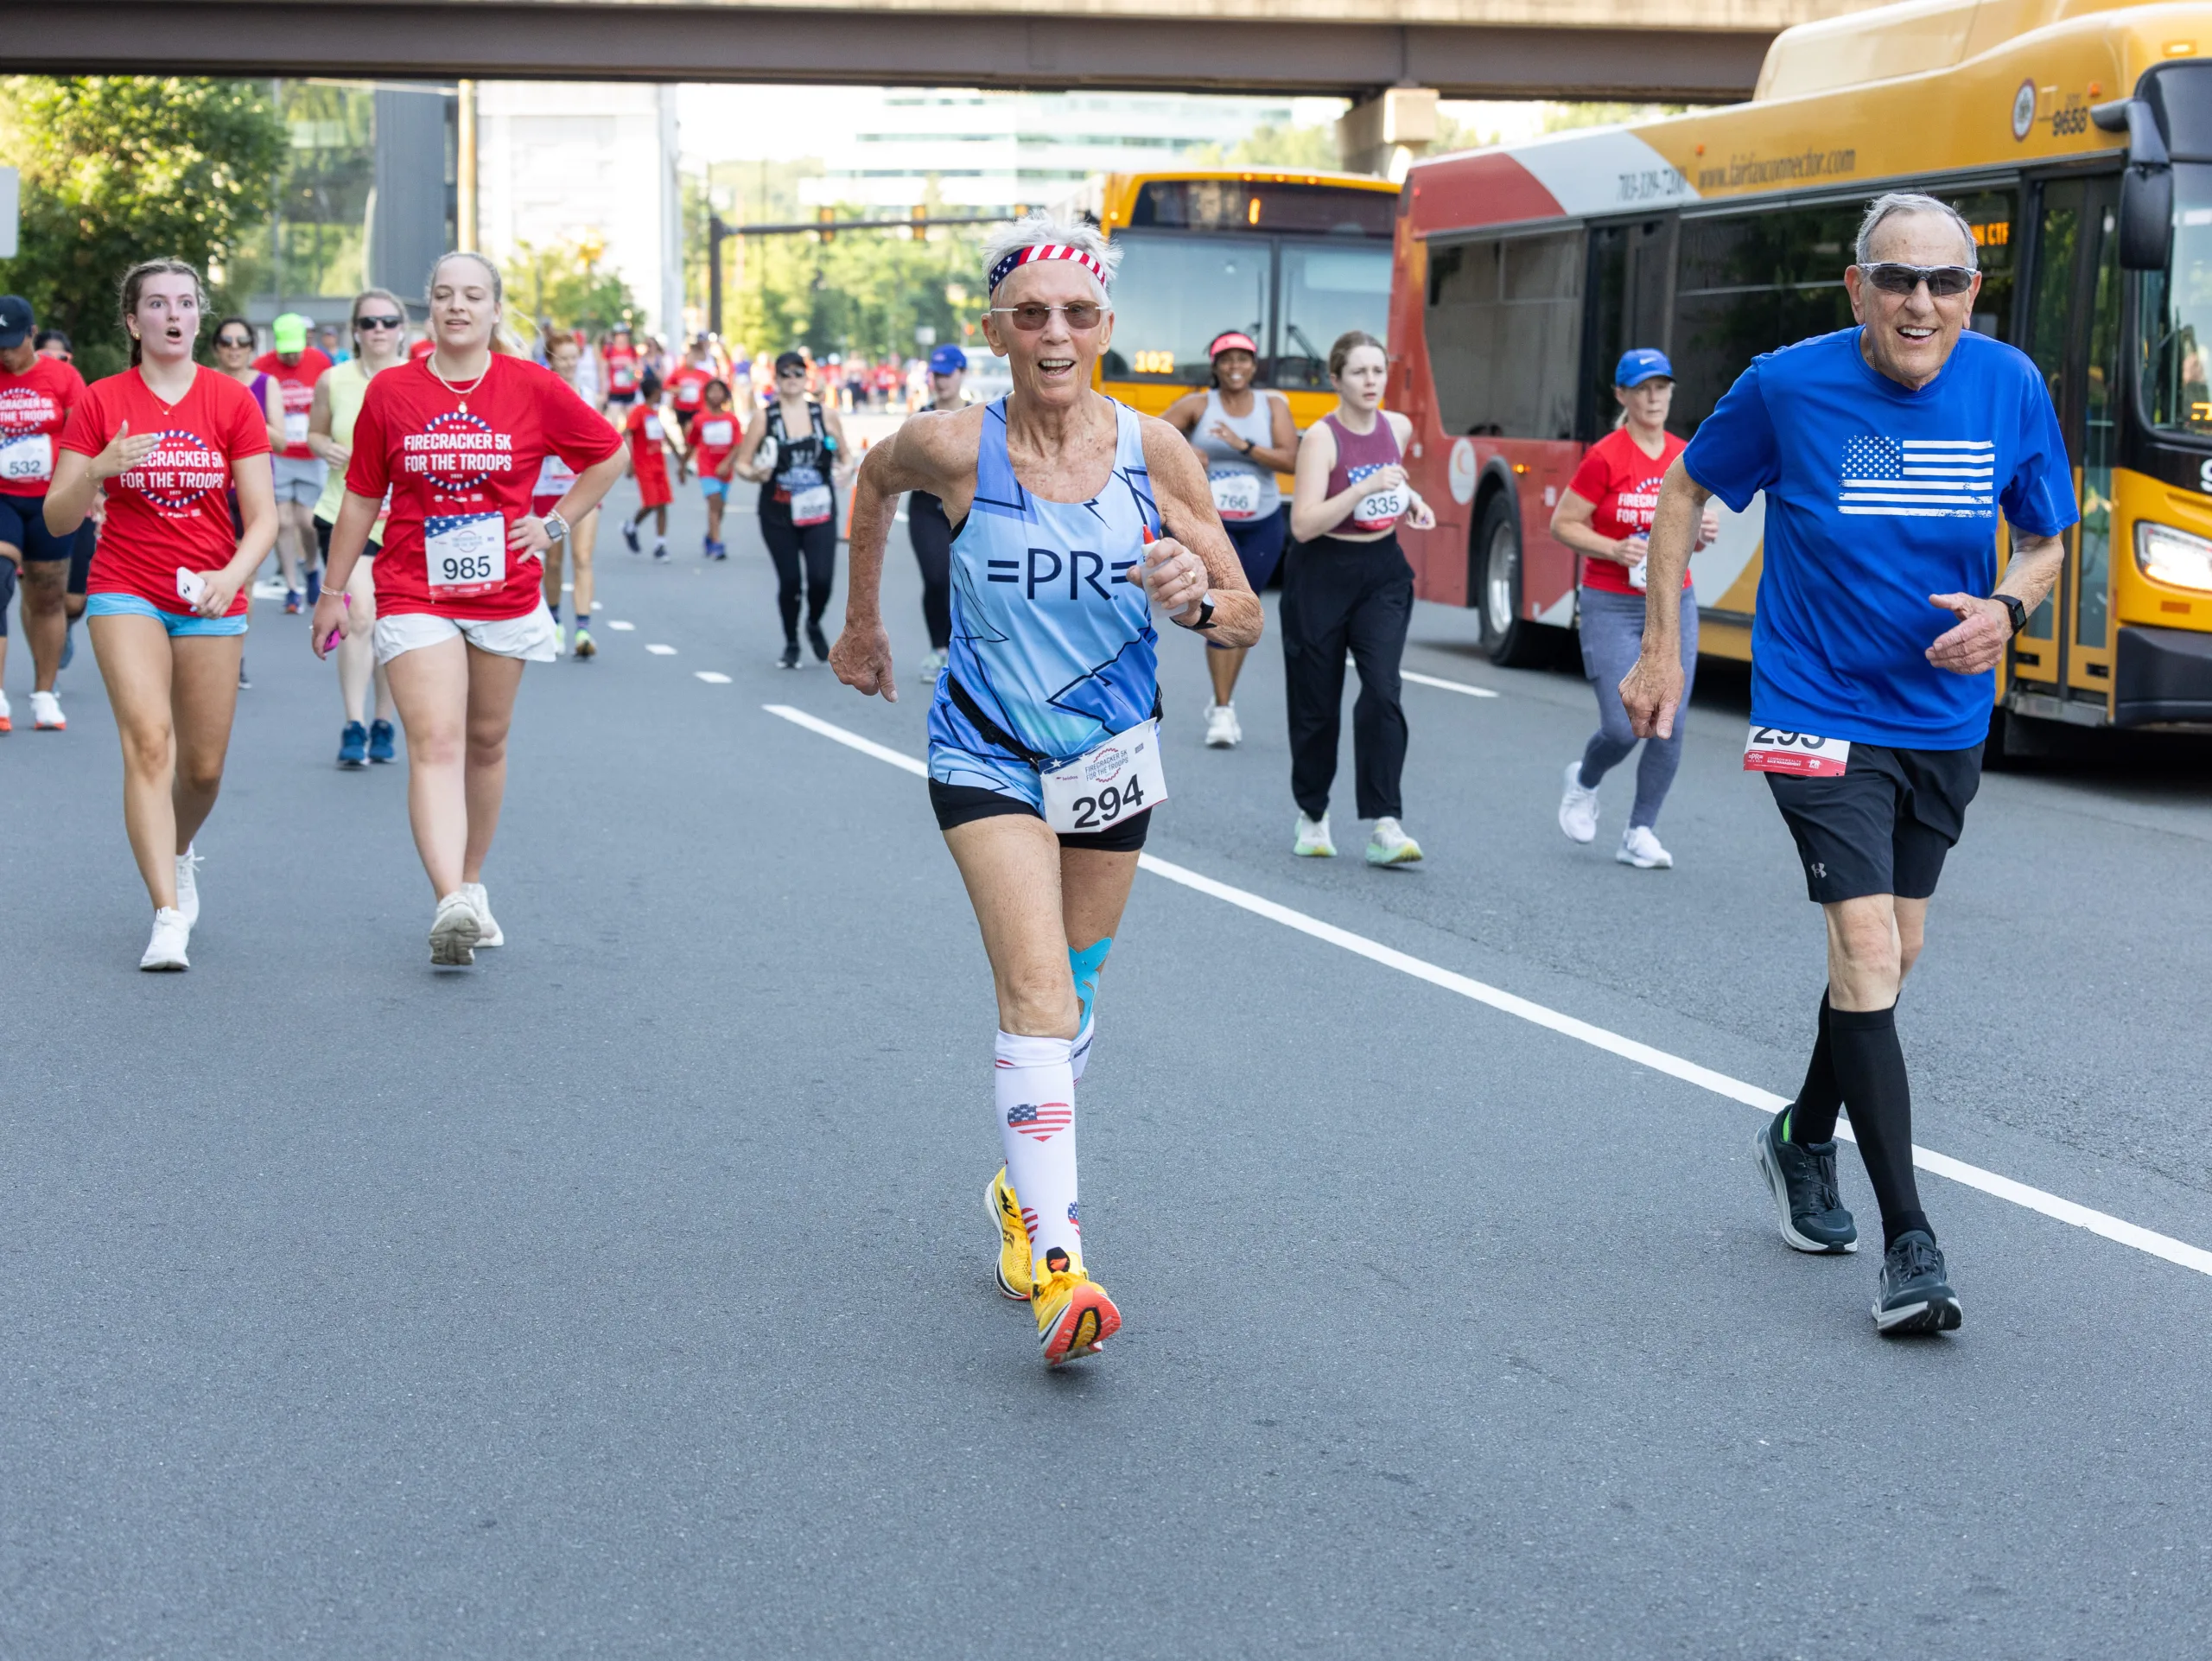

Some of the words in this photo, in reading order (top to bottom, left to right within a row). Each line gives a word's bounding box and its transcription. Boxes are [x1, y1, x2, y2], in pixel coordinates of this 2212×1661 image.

[2052, 106, 2088, 137] 9658
[19, 409, 56, 422] TROOPS
[404, 433, 493, 451] FIRECRACKER
[494, 434, 512, 450] 5K
[10, 460, 41, 475] 532
[404, 455, 428, 473] FOR
[429, 454, 456, 471] THE
[459, 454, 512, 472] TROOPS
[119, 472, 145, 488] FOR
[148, 472, 175, 488] THE
[177, 472, 225, 489] TROOPS
[1219, 493, 1249, 510] 766
[1366, 495, 1400, 517] 335
[1616, 508, 1638, 524] FOR
[442, 556, 492, 580] 985
[1084, 753, 1121, 774] FIRECRACKER
[1120, 749, 1128, 759] 5K
[1085, 772, 1097, 781] FOR
[1097, 768, 1108, 778] THE
[1109, 757, 1129, 772] TROOPS
[1072, 773, 1144, 829] 294
